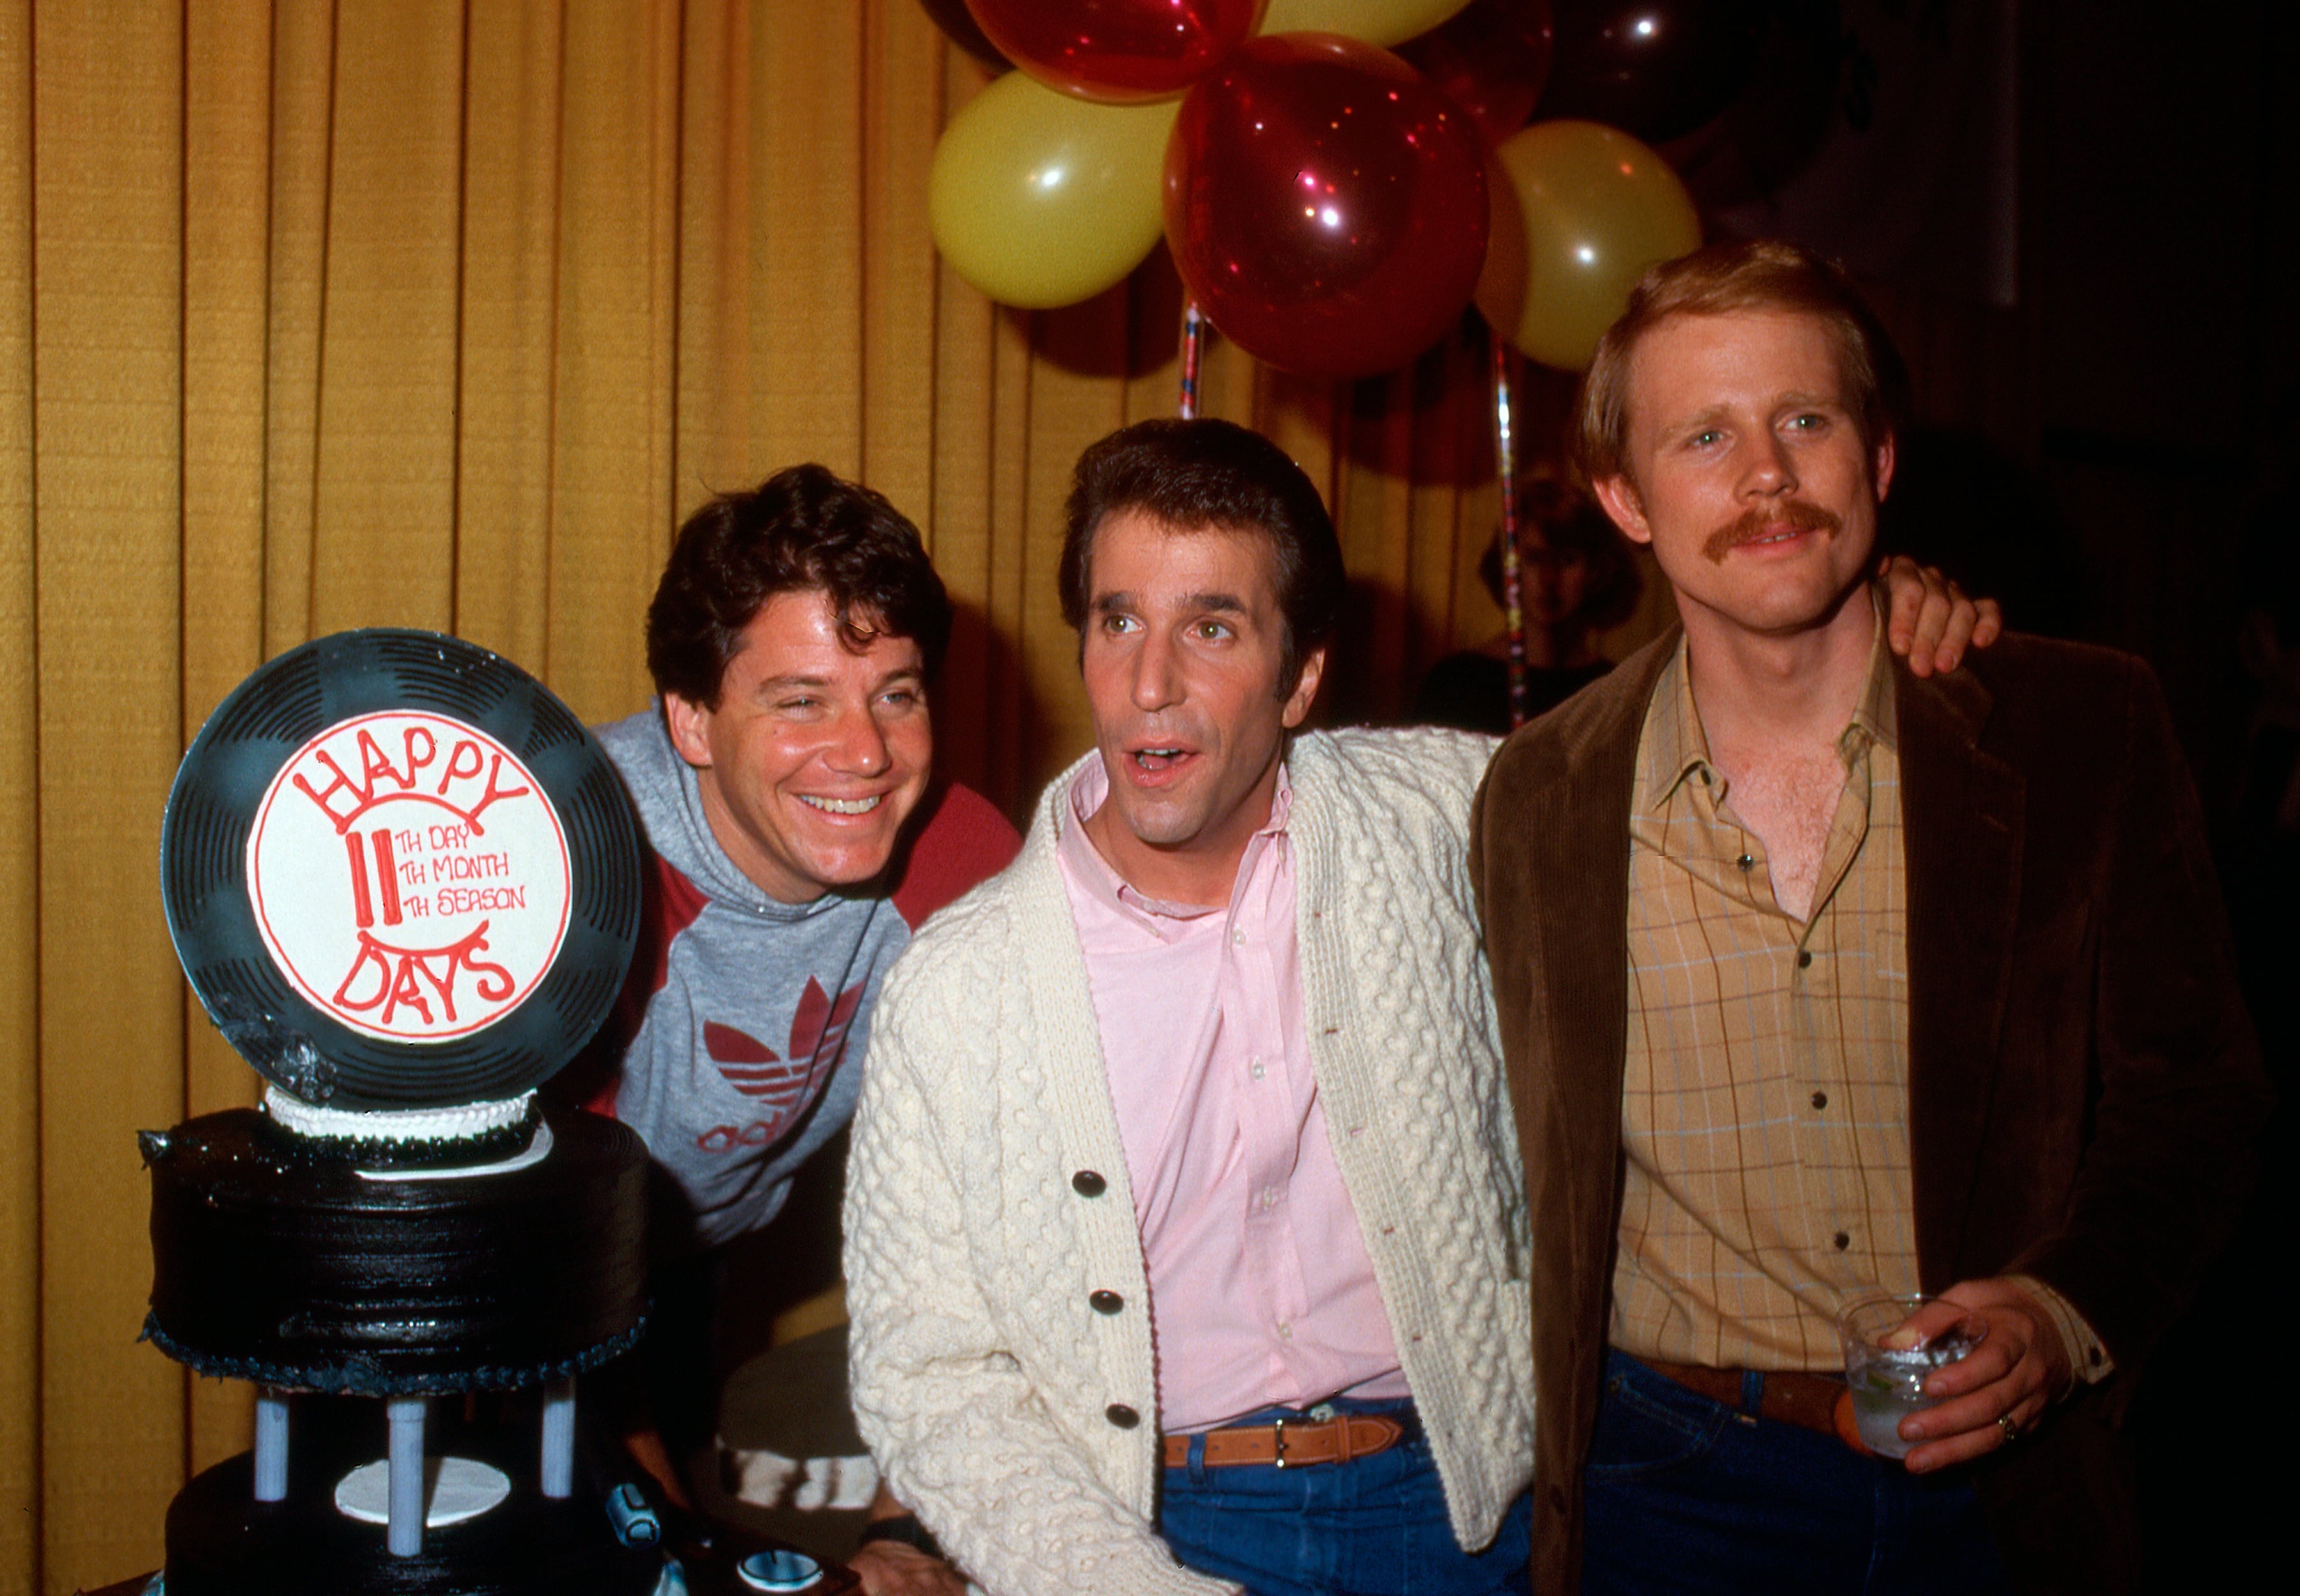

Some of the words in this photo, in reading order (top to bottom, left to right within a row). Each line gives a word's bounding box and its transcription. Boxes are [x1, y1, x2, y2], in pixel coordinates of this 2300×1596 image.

[293, 727, 529, 834] HAPPY
[395, 829, 422, 854] TH
[429, 825, 470, 849] DAY
[399, 861, 425, 885] TH
[433, 852, 509, 882] MONTH
[403, 895, 429, 917] TH
[438, 885, 526, 916] SEASON
[332, 934, 516, 1024] DAYS
